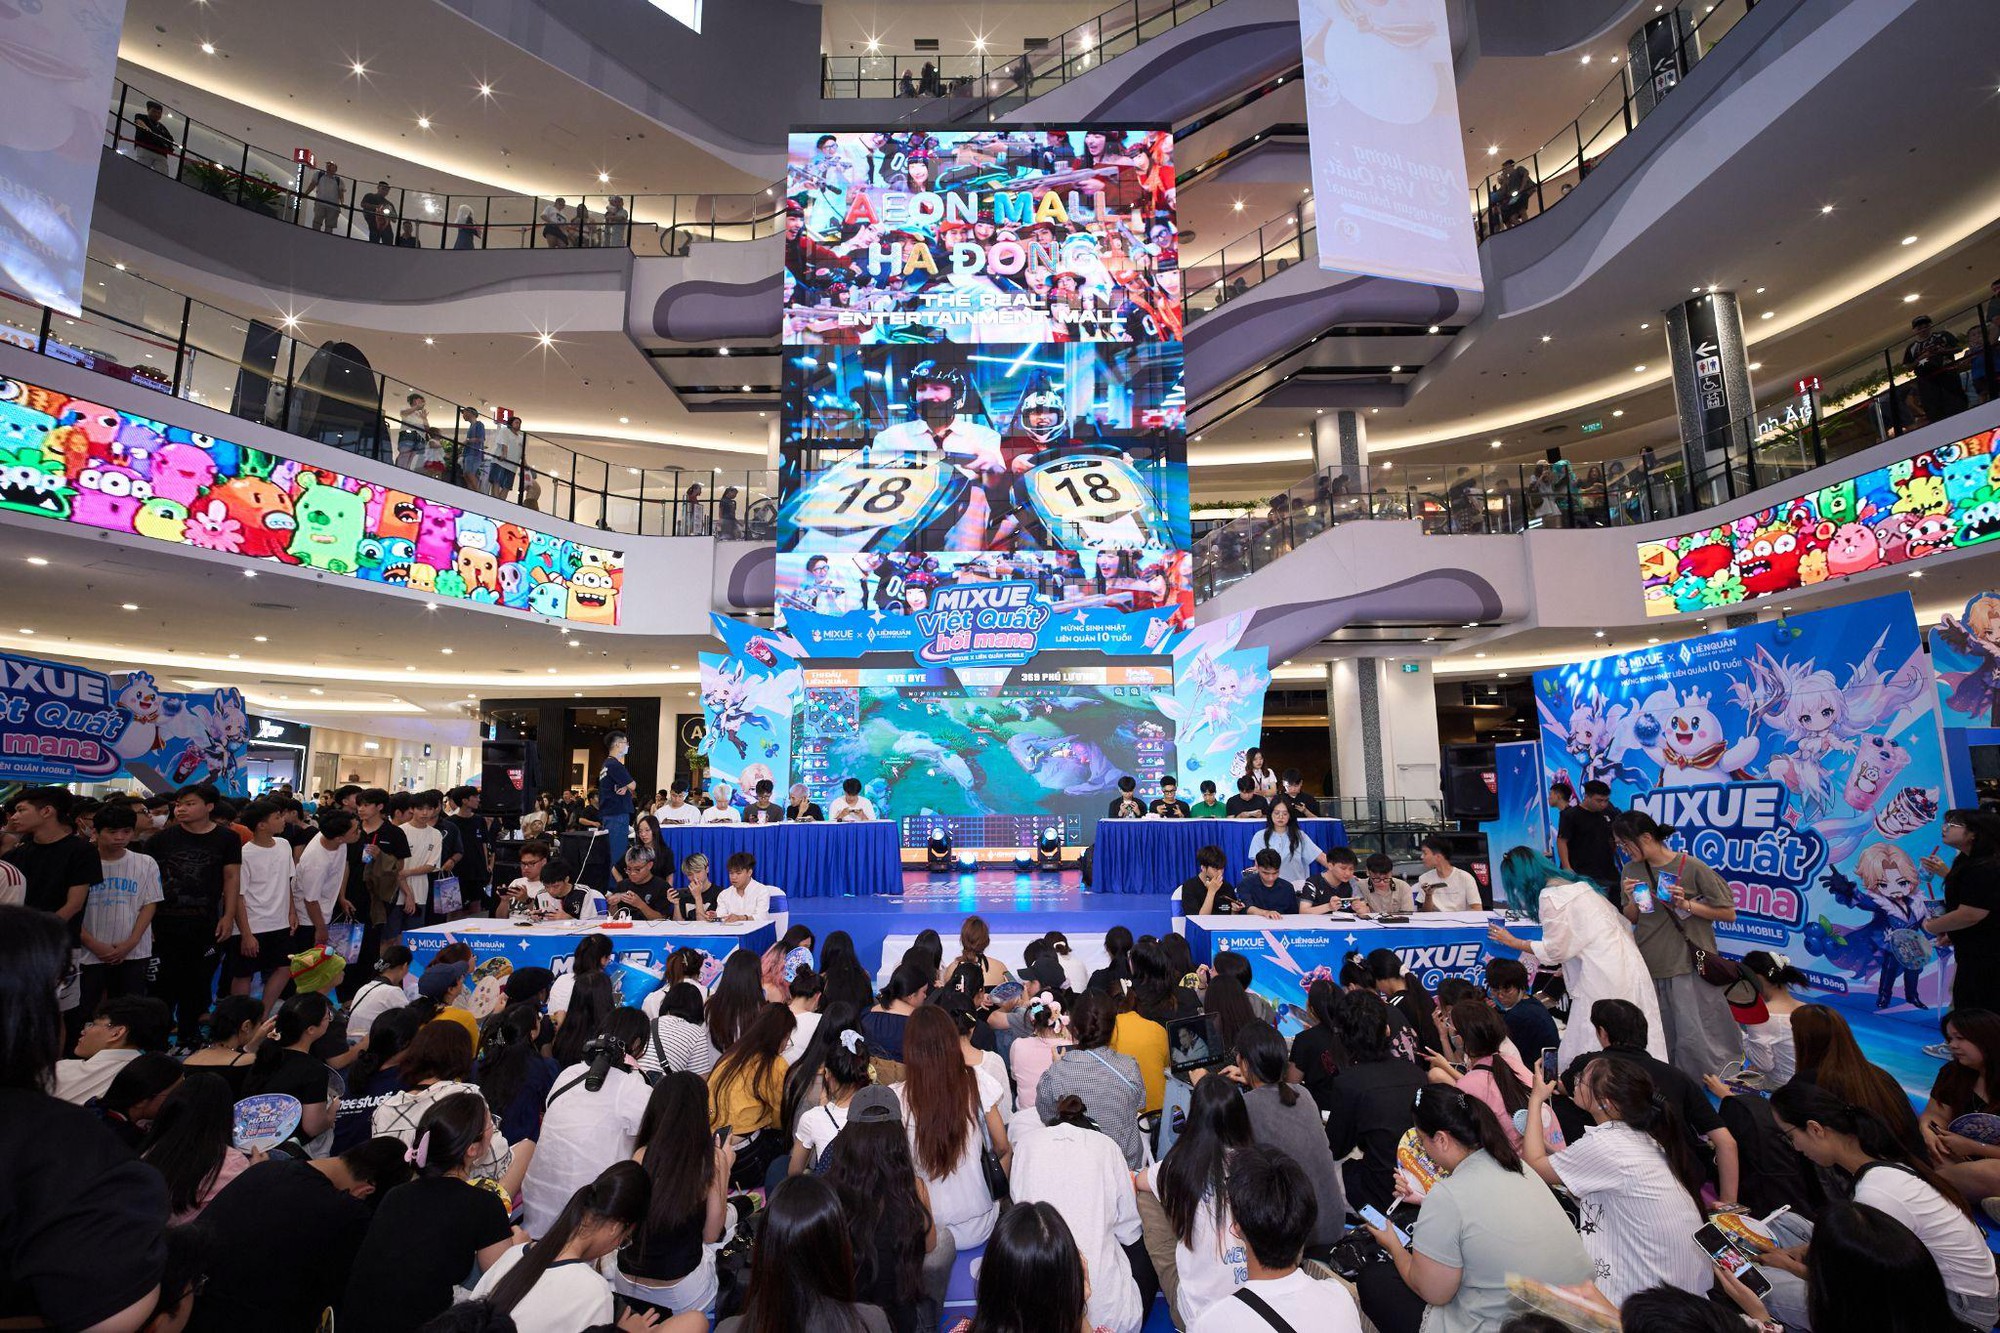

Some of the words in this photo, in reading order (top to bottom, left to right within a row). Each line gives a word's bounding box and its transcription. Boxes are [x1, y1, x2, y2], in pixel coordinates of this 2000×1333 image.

[844, 191, 978, 226] AEON
[993, 190, 1117, 225] MALL
[919, 293, 978, 307] THE
[980, 293, 1047, 308] REAL
[838, 311, 1051, 326] ENTERTAINMENT
[1058, 310, 1128, 323] MALL
[833, 476, 913, 515] 18
[1055, 473, 1121, 508] 18
[936, 586, 1031, 611] MIXUE
[918, 609, 974, 637] Việt
[976, 604, 1043, 630] Quất
[823, 629, 854, 638] MIXUE
[936, 629, 972, 653] hồi
[973, 632, 1034, 650] mana
[1097, 632, 1110, 642] 10
[1629, 652, 1665, 669] MIXUE
[1690, 637, 1737, 655] LIÊNQUÂN
[1708, 660, 1720, 672] 10
[0, 659, 105, 704] IXUE
[35, 700, 125, 740] Quất
[3, 732, 101, 761] mana
[13, 762, 39, 773] QUÂN
[40, 765, 72, 775] MOBILE
[1633, 787, 1779, 828] MIXUE
[1693, 826, 1806, 881] Quất
[1727, 880, 1799, 922] ana
[1231, 937, 1265, 947] MIXUE
[1718, 921, 1745, 934] QUÂN
[1747, 926, 1784, 939] MOBILE
[418, 939, 447, 949] MIXUE
[1809, 973, 1821, 985] Hà
[1822, 976, 1846, 992] Đông
[248, 1114, 278, 1124] MIXUE
